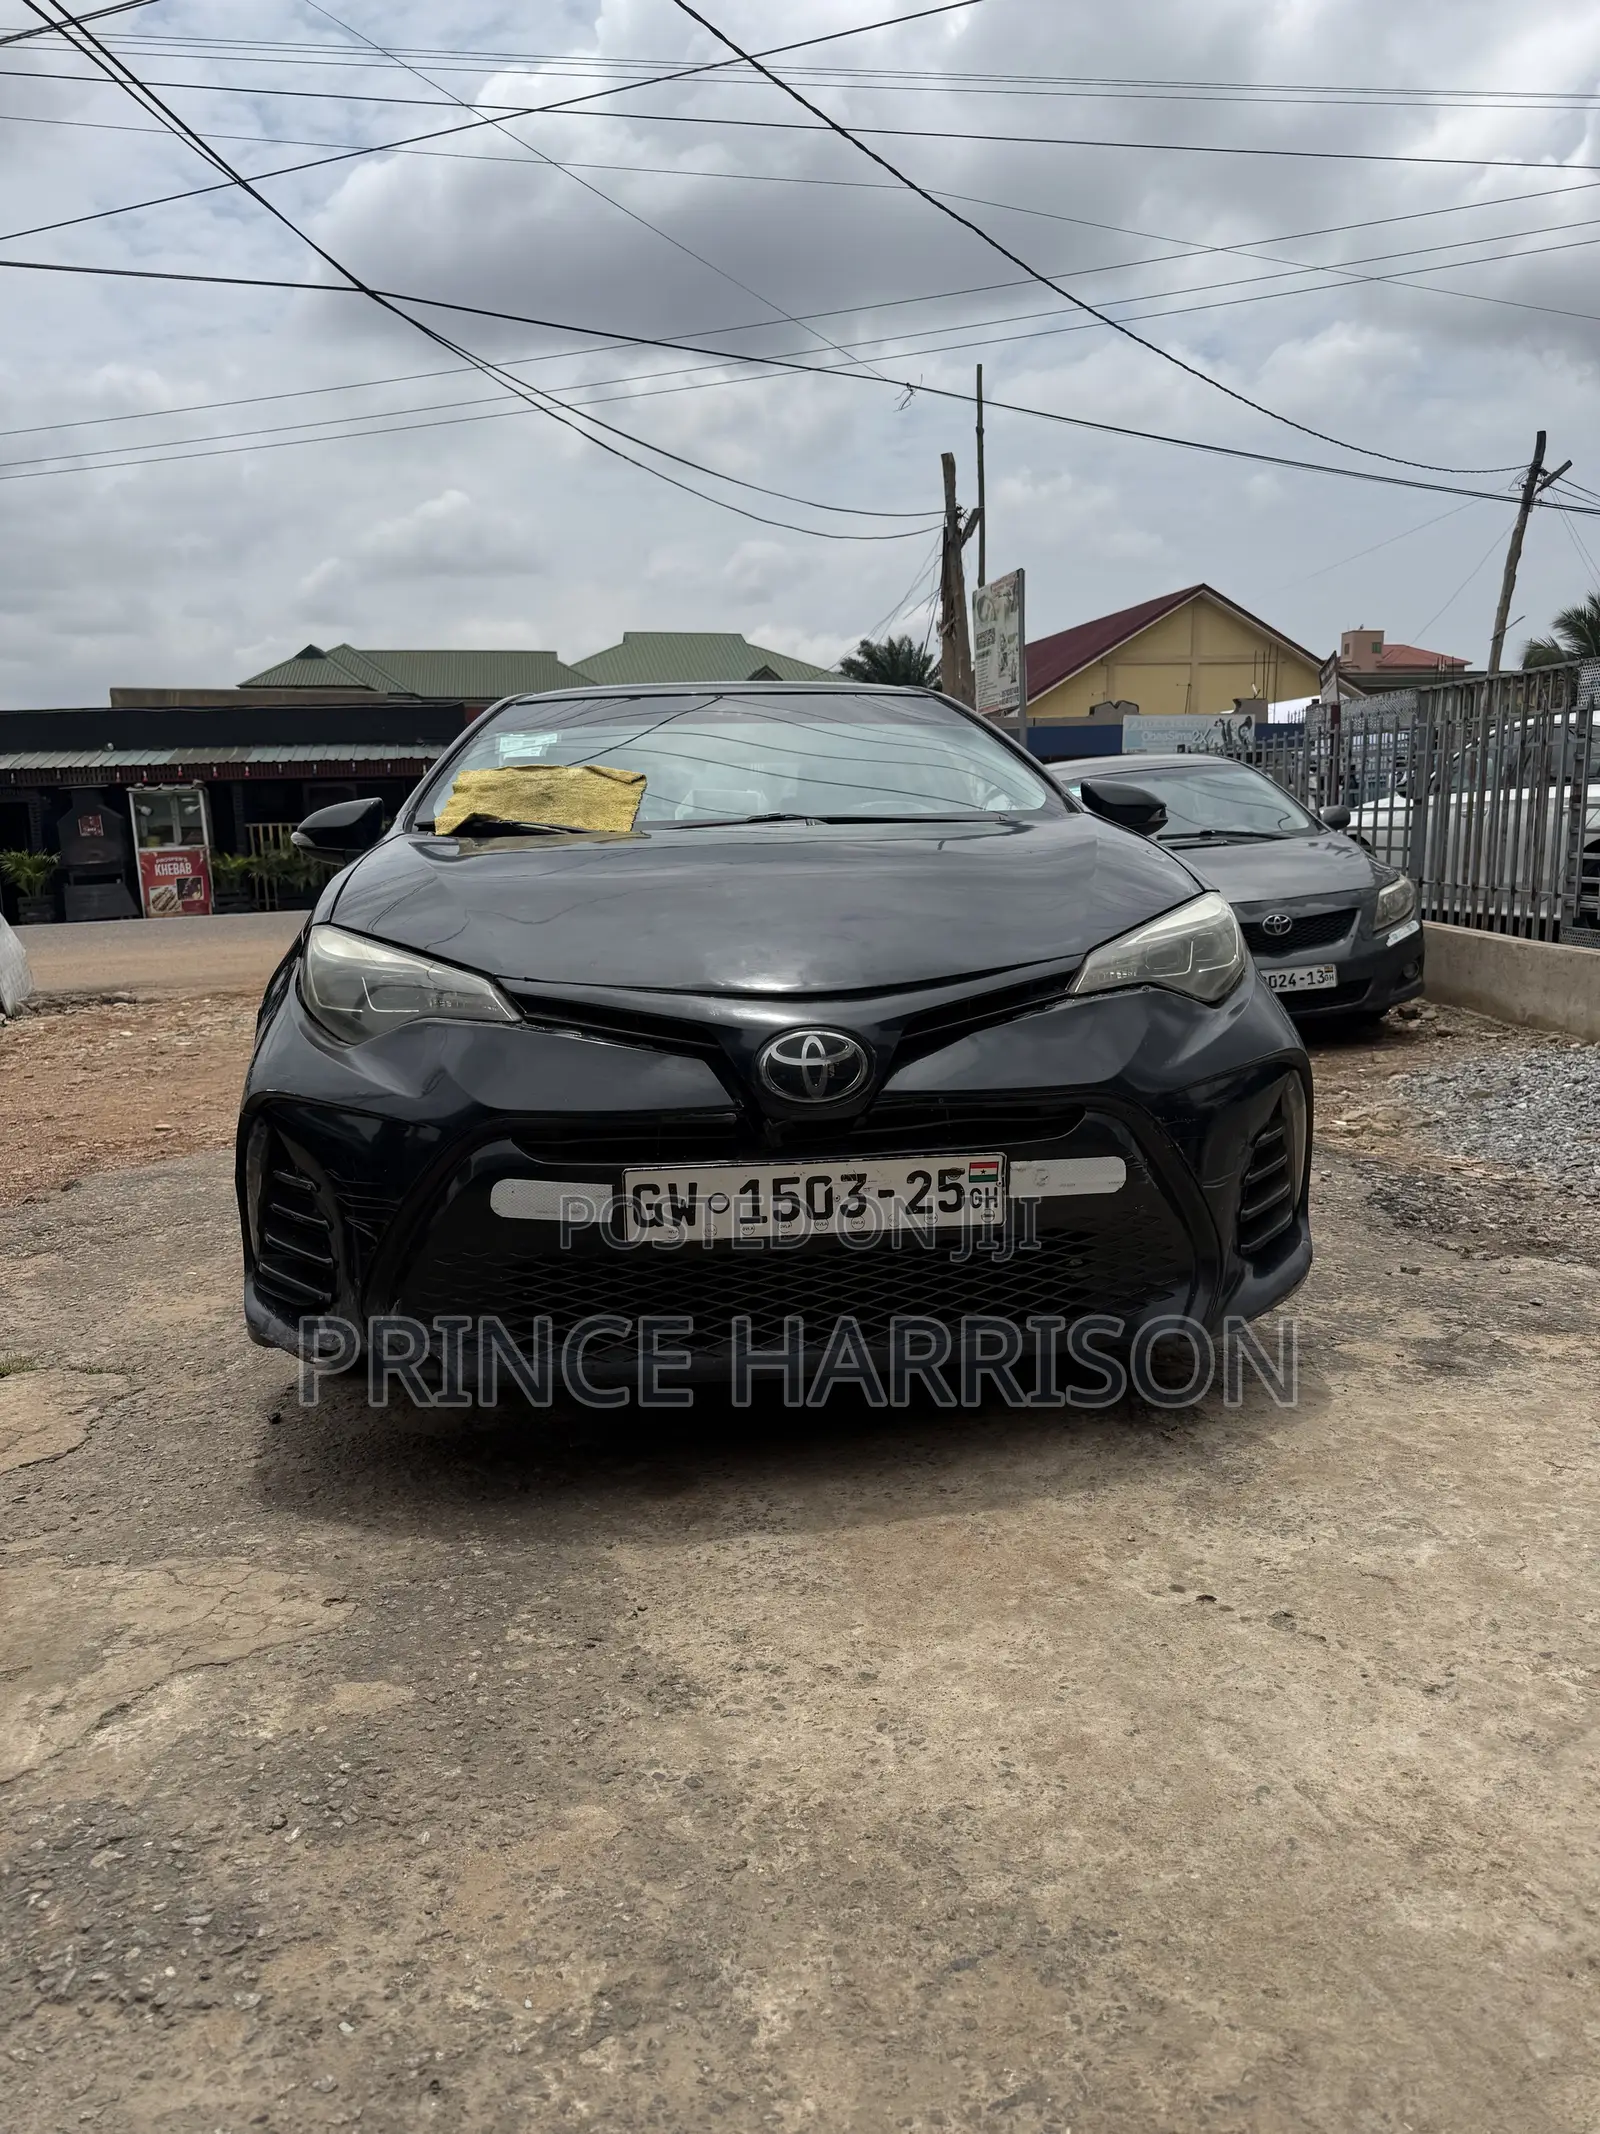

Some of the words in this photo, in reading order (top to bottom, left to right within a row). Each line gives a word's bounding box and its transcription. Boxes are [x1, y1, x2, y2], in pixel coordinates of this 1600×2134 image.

[154, 862, 192, 876] KHEBAB
[1263, 969, 1325, 989] 024-13
[632, 1182, 698, 1228] GW
[739, 1168, 966, 1224] 1503-25
[969, 1186, 999, 1209] GH
